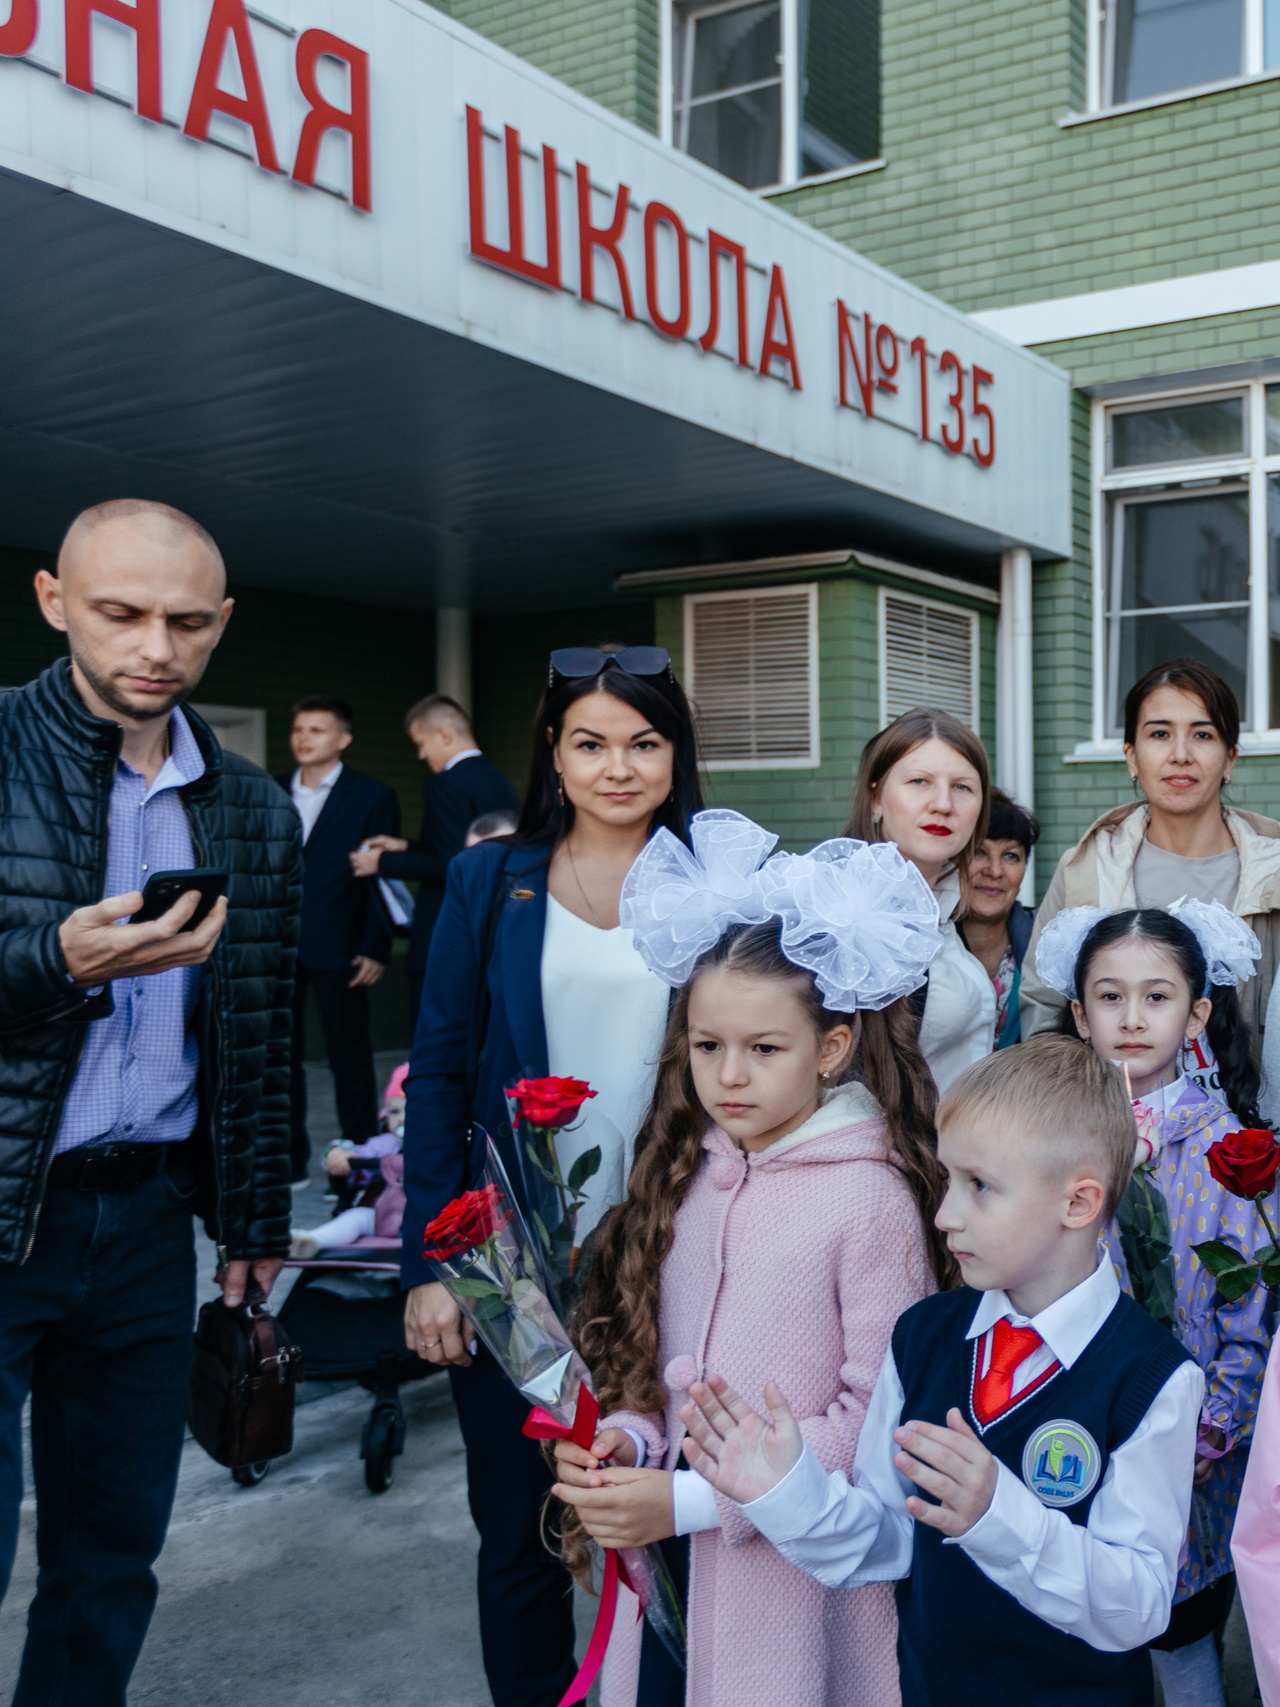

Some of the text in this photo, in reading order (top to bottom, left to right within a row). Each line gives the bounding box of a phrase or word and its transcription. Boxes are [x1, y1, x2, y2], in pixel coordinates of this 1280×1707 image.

[0, 0, 996, 470] НАЯ ШКОЛА №135
